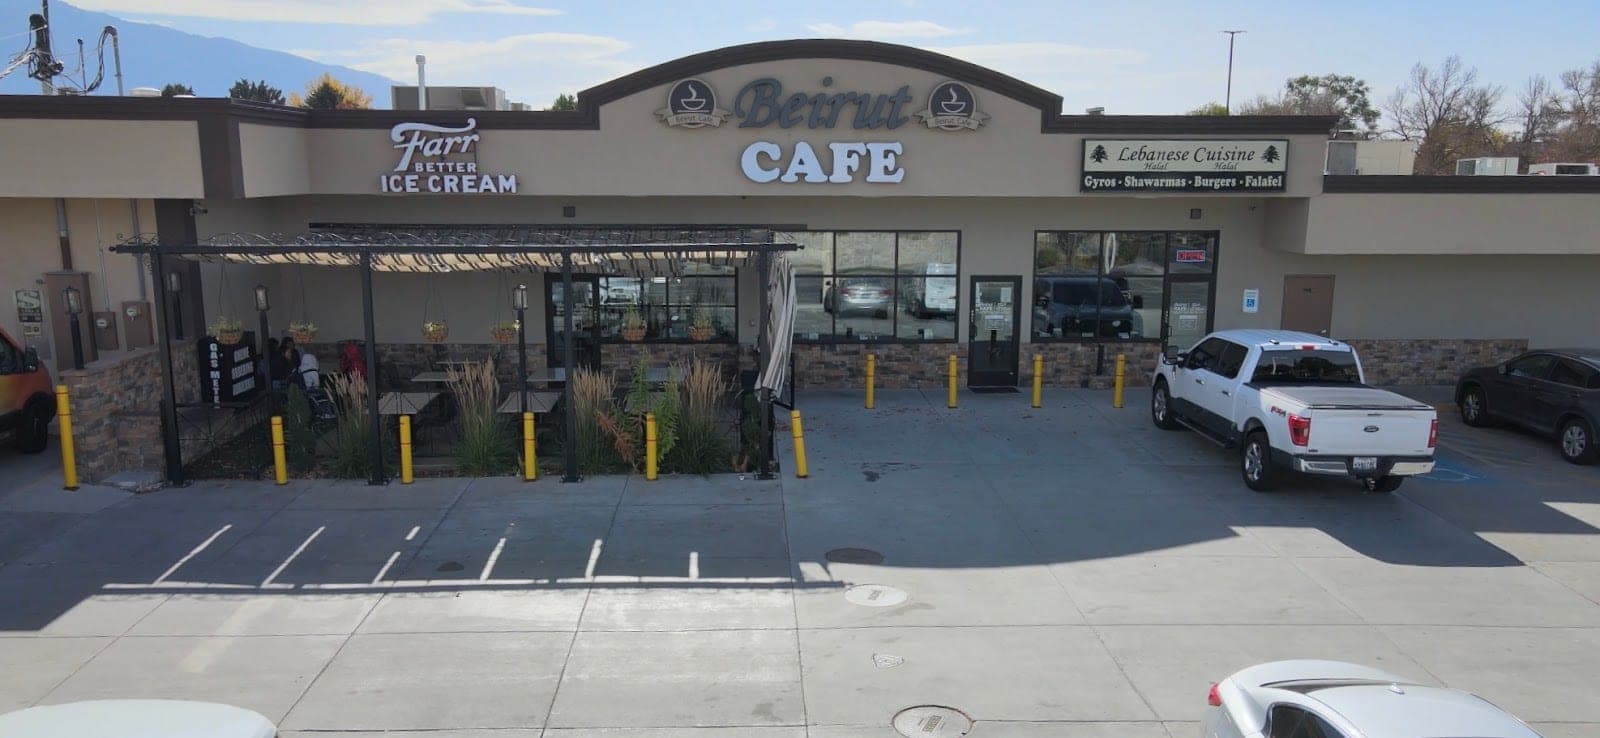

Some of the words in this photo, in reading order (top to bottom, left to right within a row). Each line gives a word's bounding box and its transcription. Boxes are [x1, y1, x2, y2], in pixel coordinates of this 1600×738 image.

[734, 76, 914, 130] Beirut
[391, 118, 480, 172] Farr
[1118, 145, 1190, 161] Lebanese
[1193, 146, 1256, 163] Cuisine
[414, 162, 477, 173] BETTER
[740, 141, 906, 184] CAFE
[1143, 162, 1168, 170] Halal
[1214, 162, 1239, 170] Halal
[381, 174, 420, 193] ICE
[427, 174, 517, 194] CREAM
[1084, 175, 1117, 188] Gyros
[1124, 175, 1187, 187] Shawarmas
[1194, 175, 1237, 189] Burgers
[1244, 175, 1282, 187] Falafel
[210, 343, 219, 368] GAS
[210, 371, 221, 408] METE
